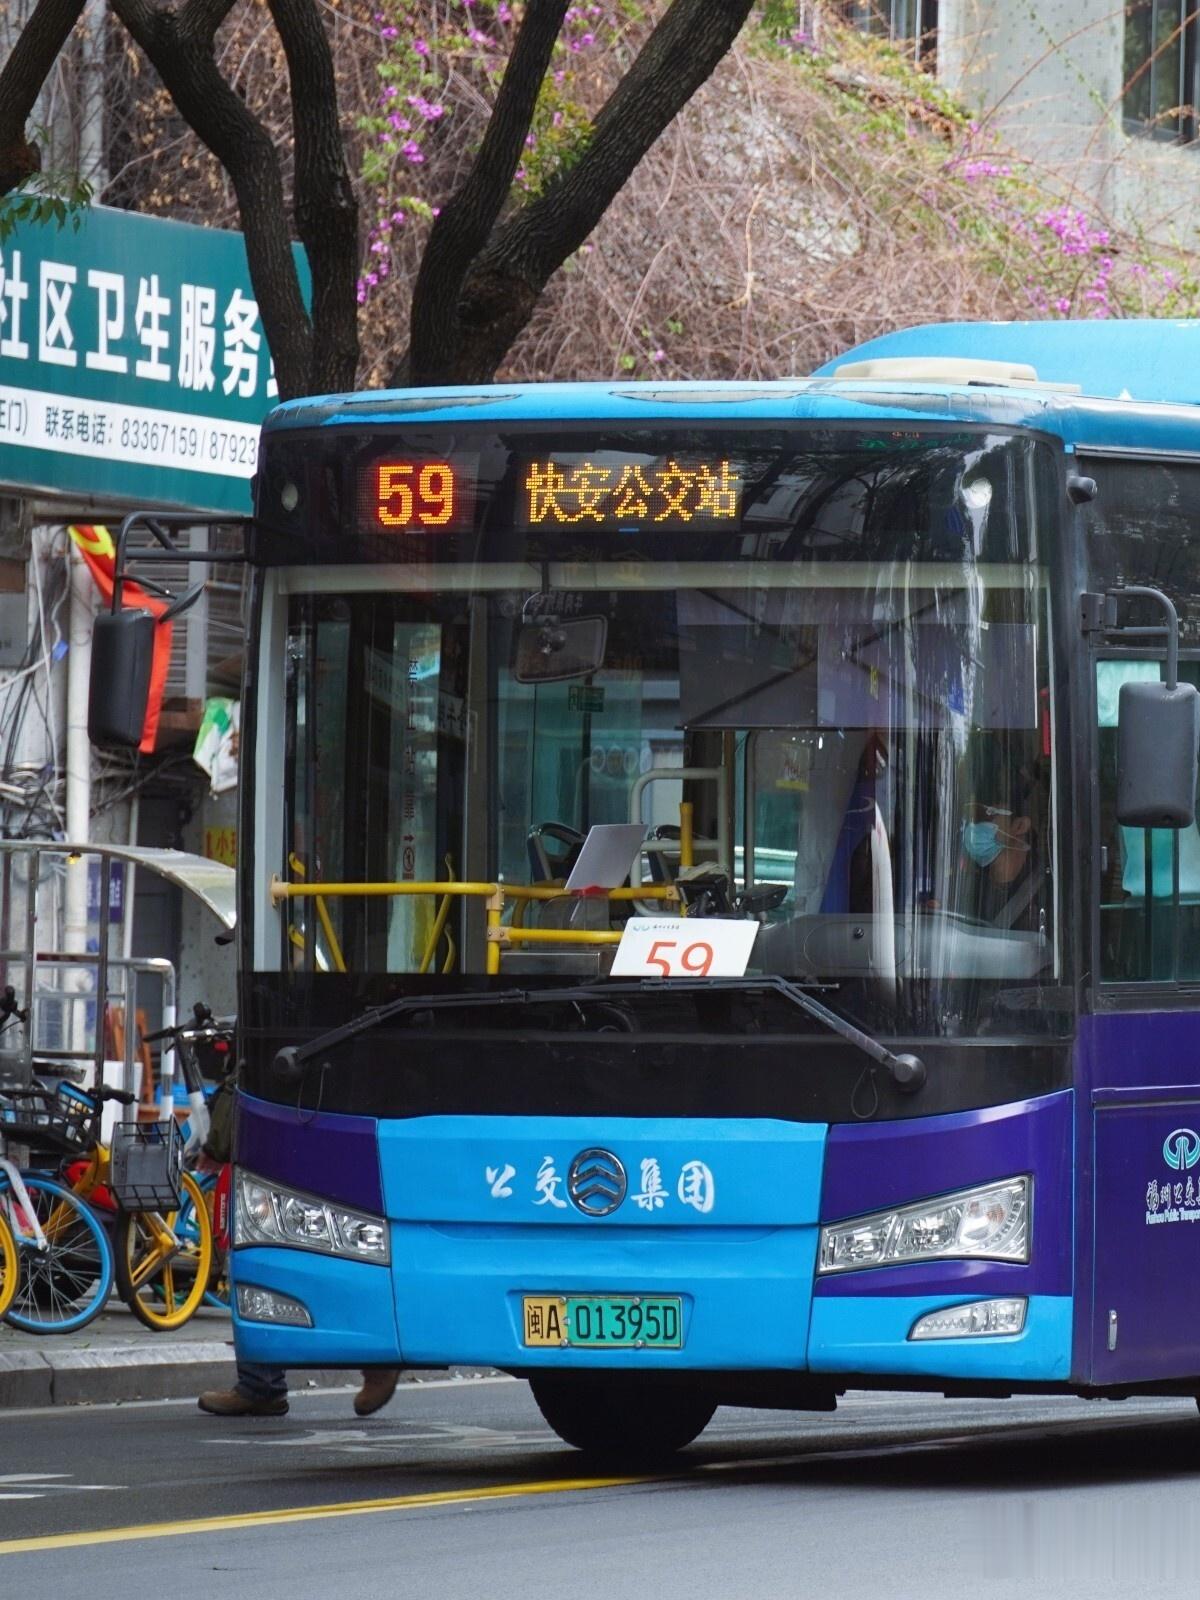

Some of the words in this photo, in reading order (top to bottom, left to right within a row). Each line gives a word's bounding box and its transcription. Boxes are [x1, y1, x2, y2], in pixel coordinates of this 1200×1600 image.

[0, 250, 279, 398] 社区卫生服务
[378, 464, 454, 525] 59
[526, 461, 739, 523] 快安公交站
[646, 941, 714, 976] 59
